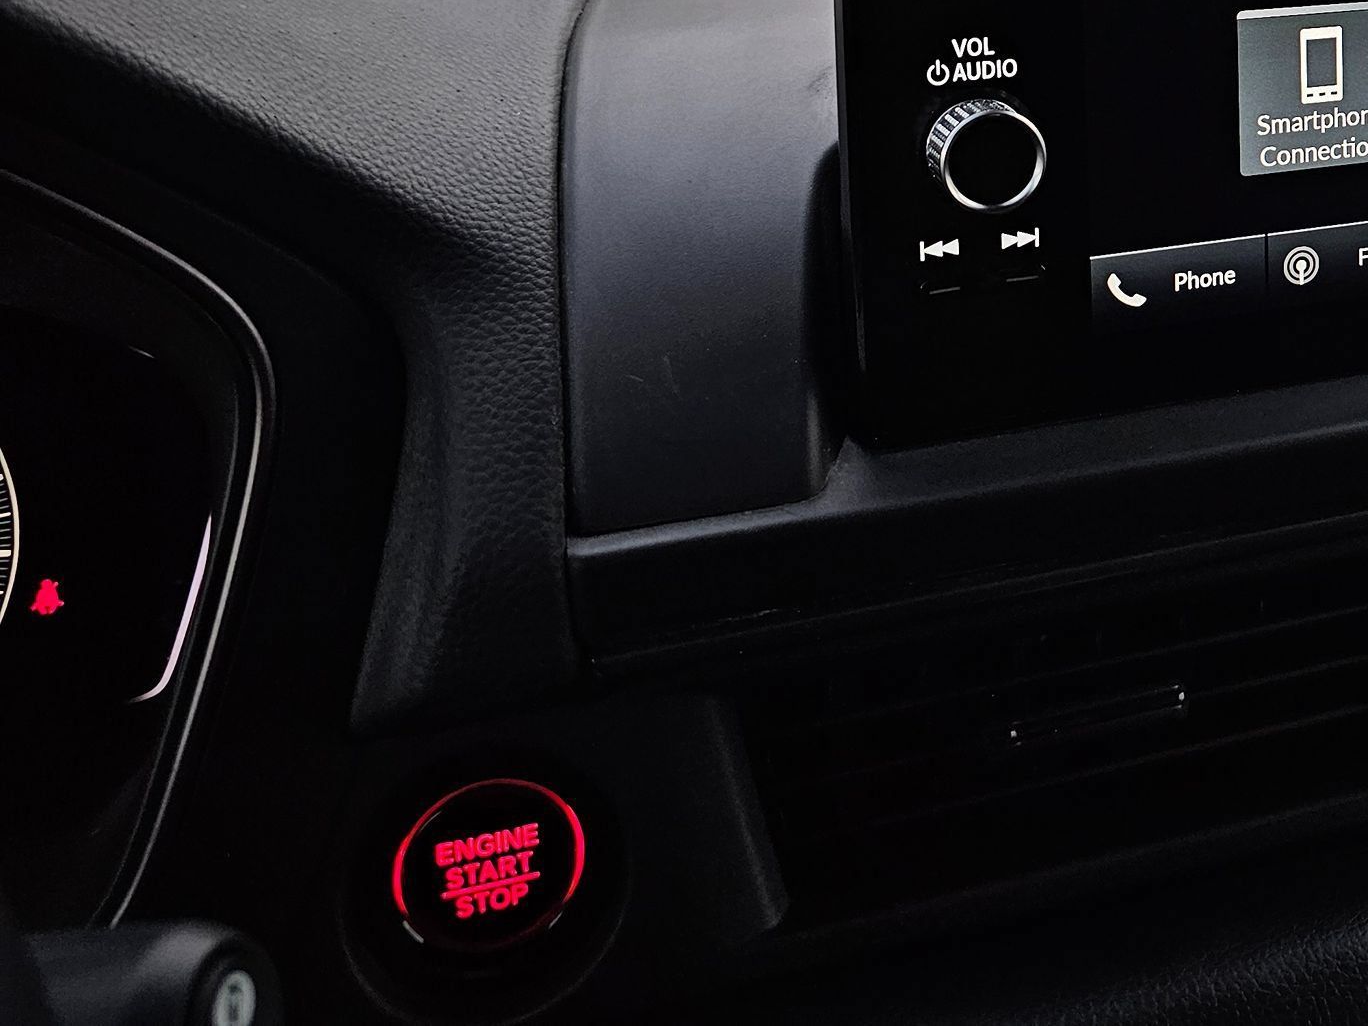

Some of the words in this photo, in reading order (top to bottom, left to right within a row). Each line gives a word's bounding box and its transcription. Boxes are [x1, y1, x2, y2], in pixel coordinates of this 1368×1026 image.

[951, 36, 995, 58] VOL
[952, 58, 1018, 82] AUDIO
[1174, 269, 1236, 292] Phone
[434, 822, 540, 868] ENGINE
[445, 850, 534, 890] START
[455, 882, 529, 919] STOP
